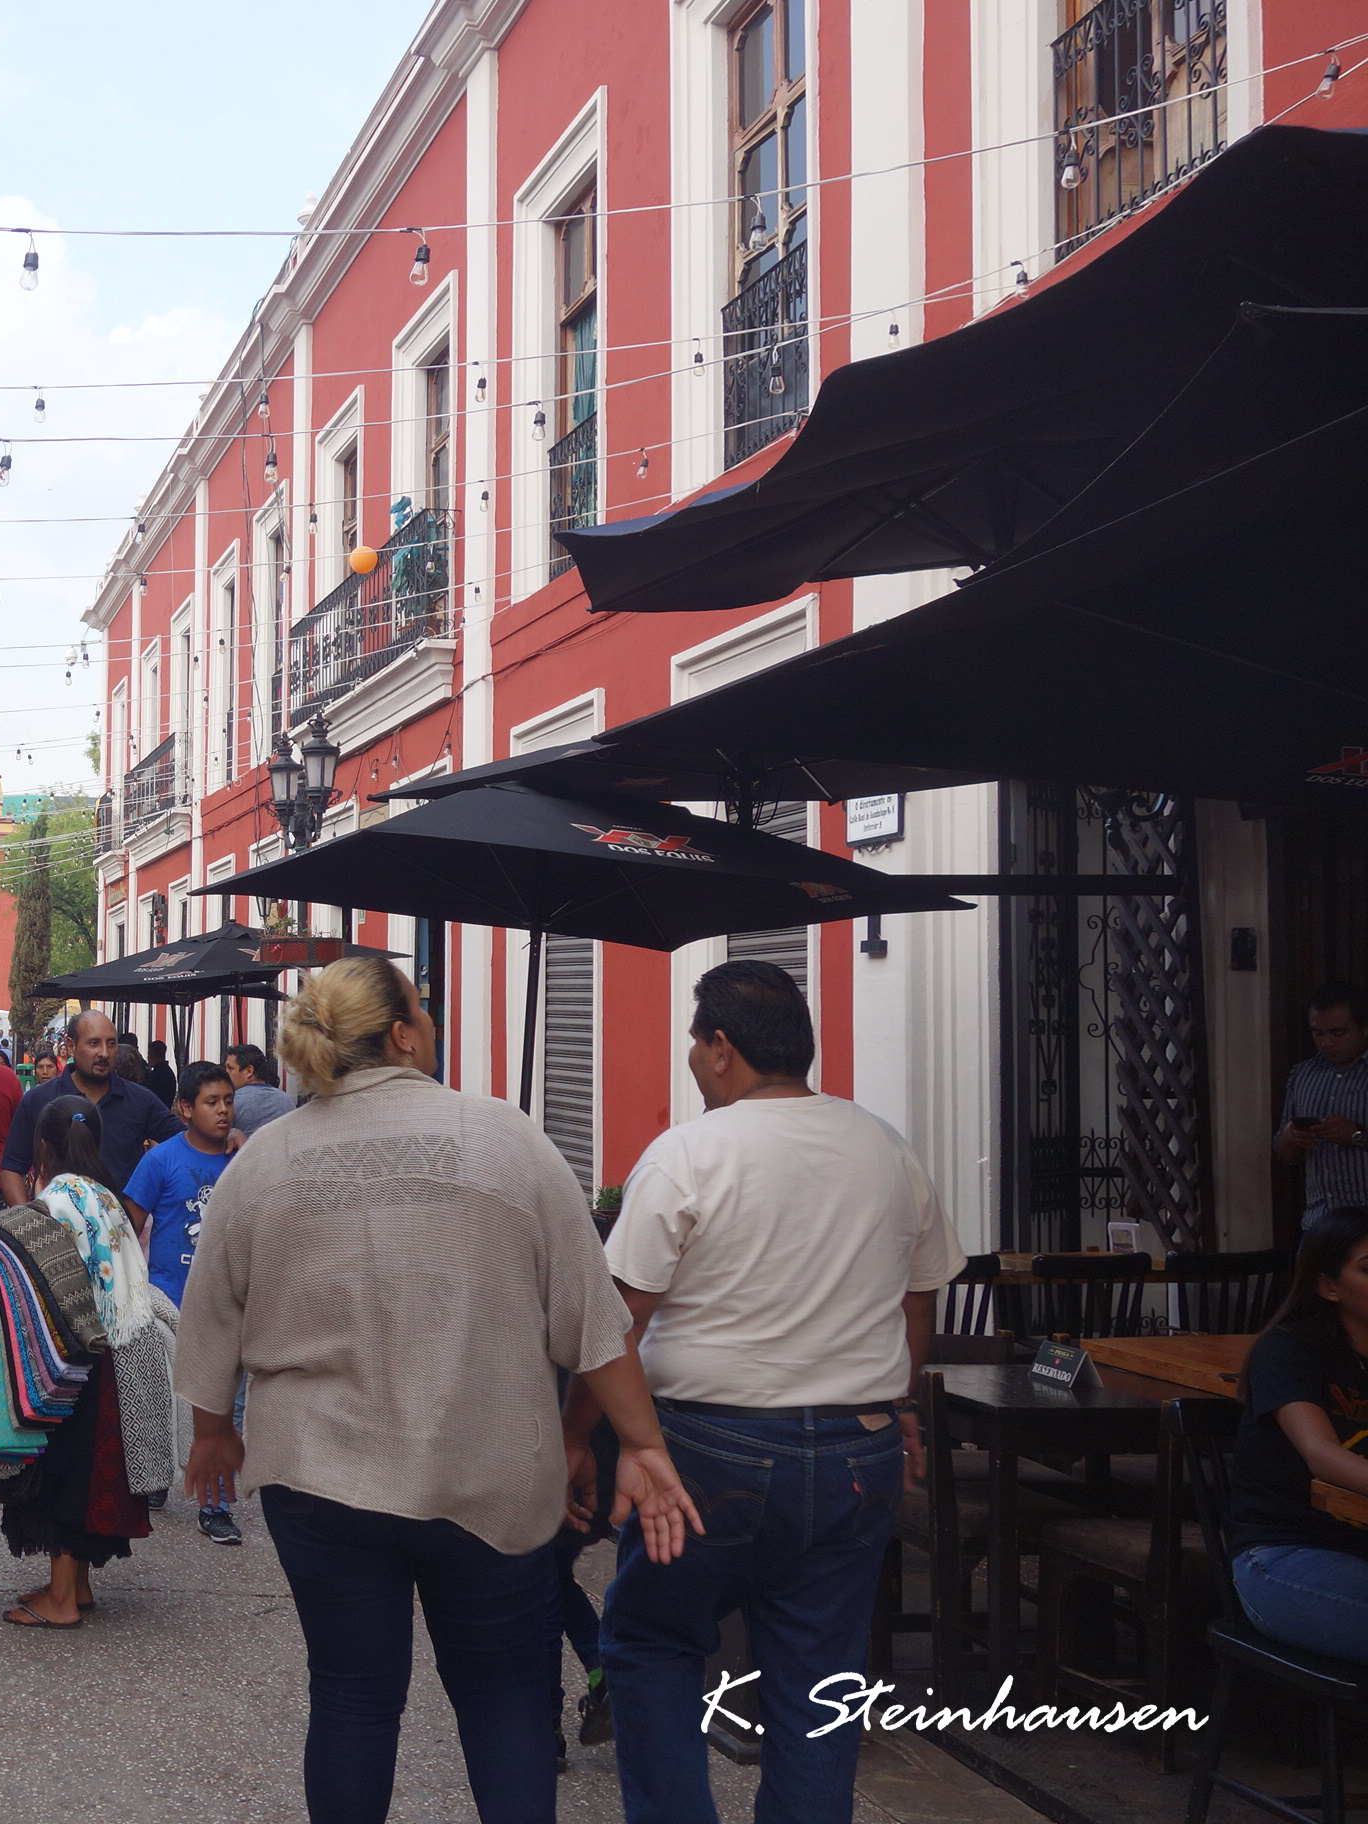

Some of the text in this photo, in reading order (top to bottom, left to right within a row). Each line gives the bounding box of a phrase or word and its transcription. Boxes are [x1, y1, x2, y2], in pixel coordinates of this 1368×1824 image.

[1305, 775, 1345, 784] DOS
[607, 844, 715, 863] DOS EQUIS
[1031, 1363, 1072, 1383] RESERVADO
